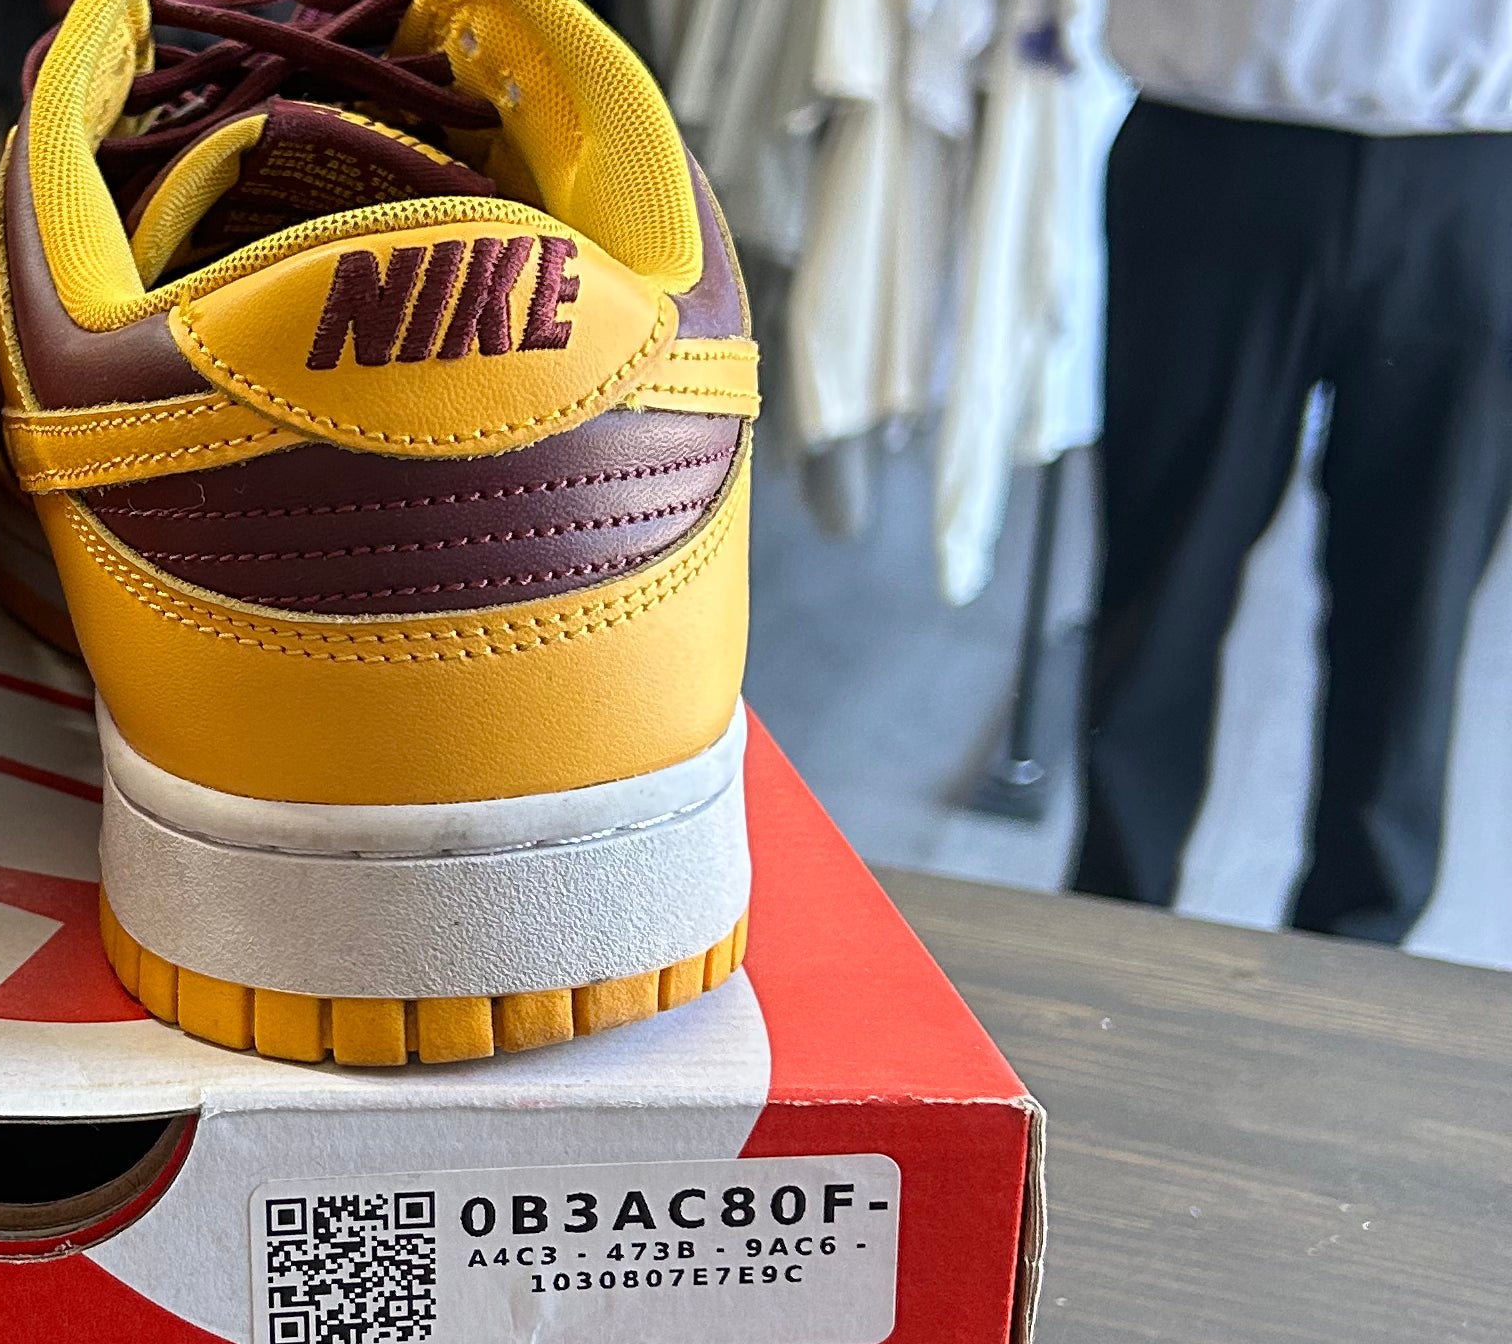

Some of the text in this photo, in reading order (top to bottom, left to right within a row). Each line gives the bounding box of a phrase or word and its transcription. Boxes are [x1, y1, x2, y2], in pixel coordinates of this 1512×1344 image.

[305, 234, 581, 370] NIKE
[460, 1183, 889, 1238] 0B3AC80F-
[467, 1246, 558, 1267] A4C3
[606, 1241, 696, 1261] 473B
[745, 1235, 837, 1256] 9AC6
[531, 1264, 804, 1293] 1030807E7E9C
